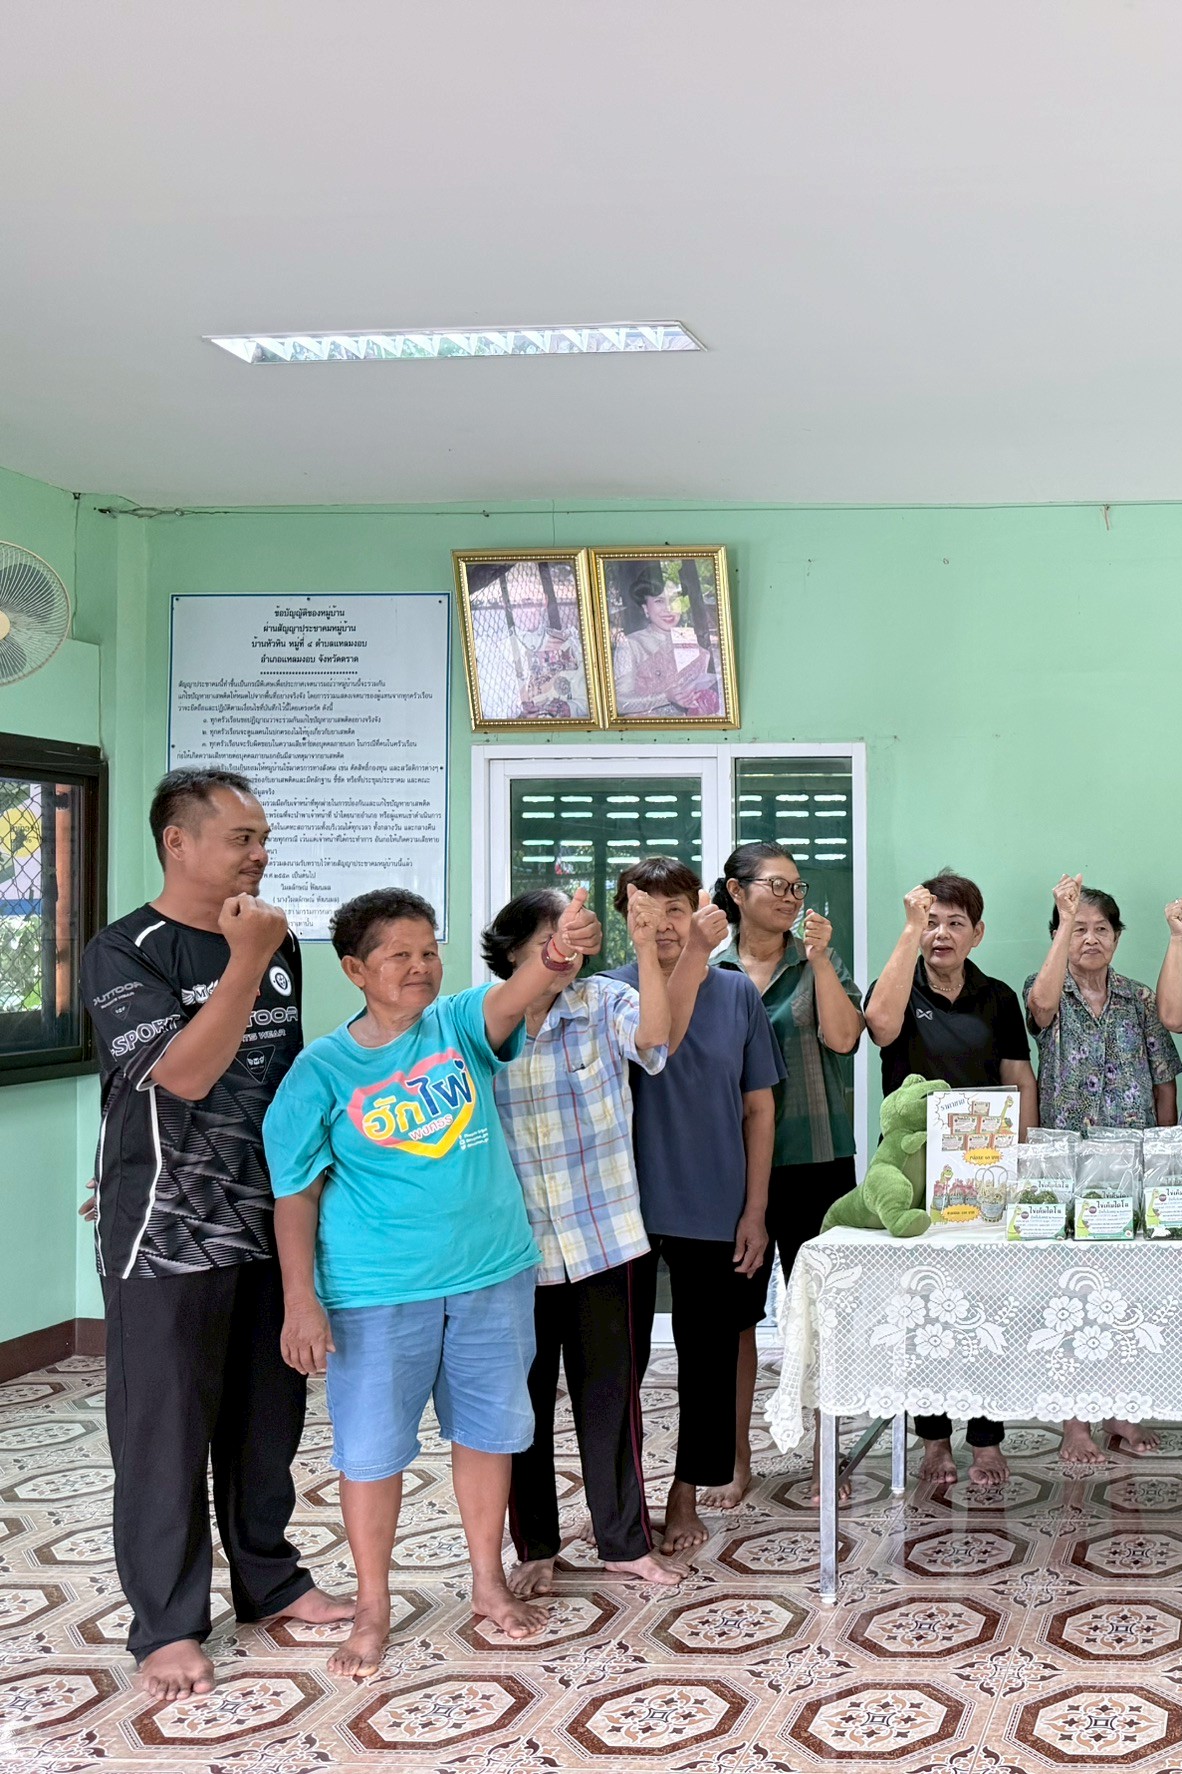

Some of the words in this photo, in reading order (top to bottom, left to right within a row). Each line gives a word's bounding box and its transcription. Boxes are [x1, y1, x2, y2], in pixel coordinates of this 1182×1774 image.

[251, 636, 286, 648] บ้านหัวหิน
[289, 633, 305, 651] หมู่ที่
[315, 638, 367, 648] ตำบลแหลมงอบ
[260, 654, 316, 663] อำเภอแหลมงอบ
[318, 654, 359, 663] จังหวัดตราด
[1096, 1200, 1129, 1209] ไข่เค็มไดโน
[1029, 1206, 1062, 1215] ไข่เค็มไดโน
